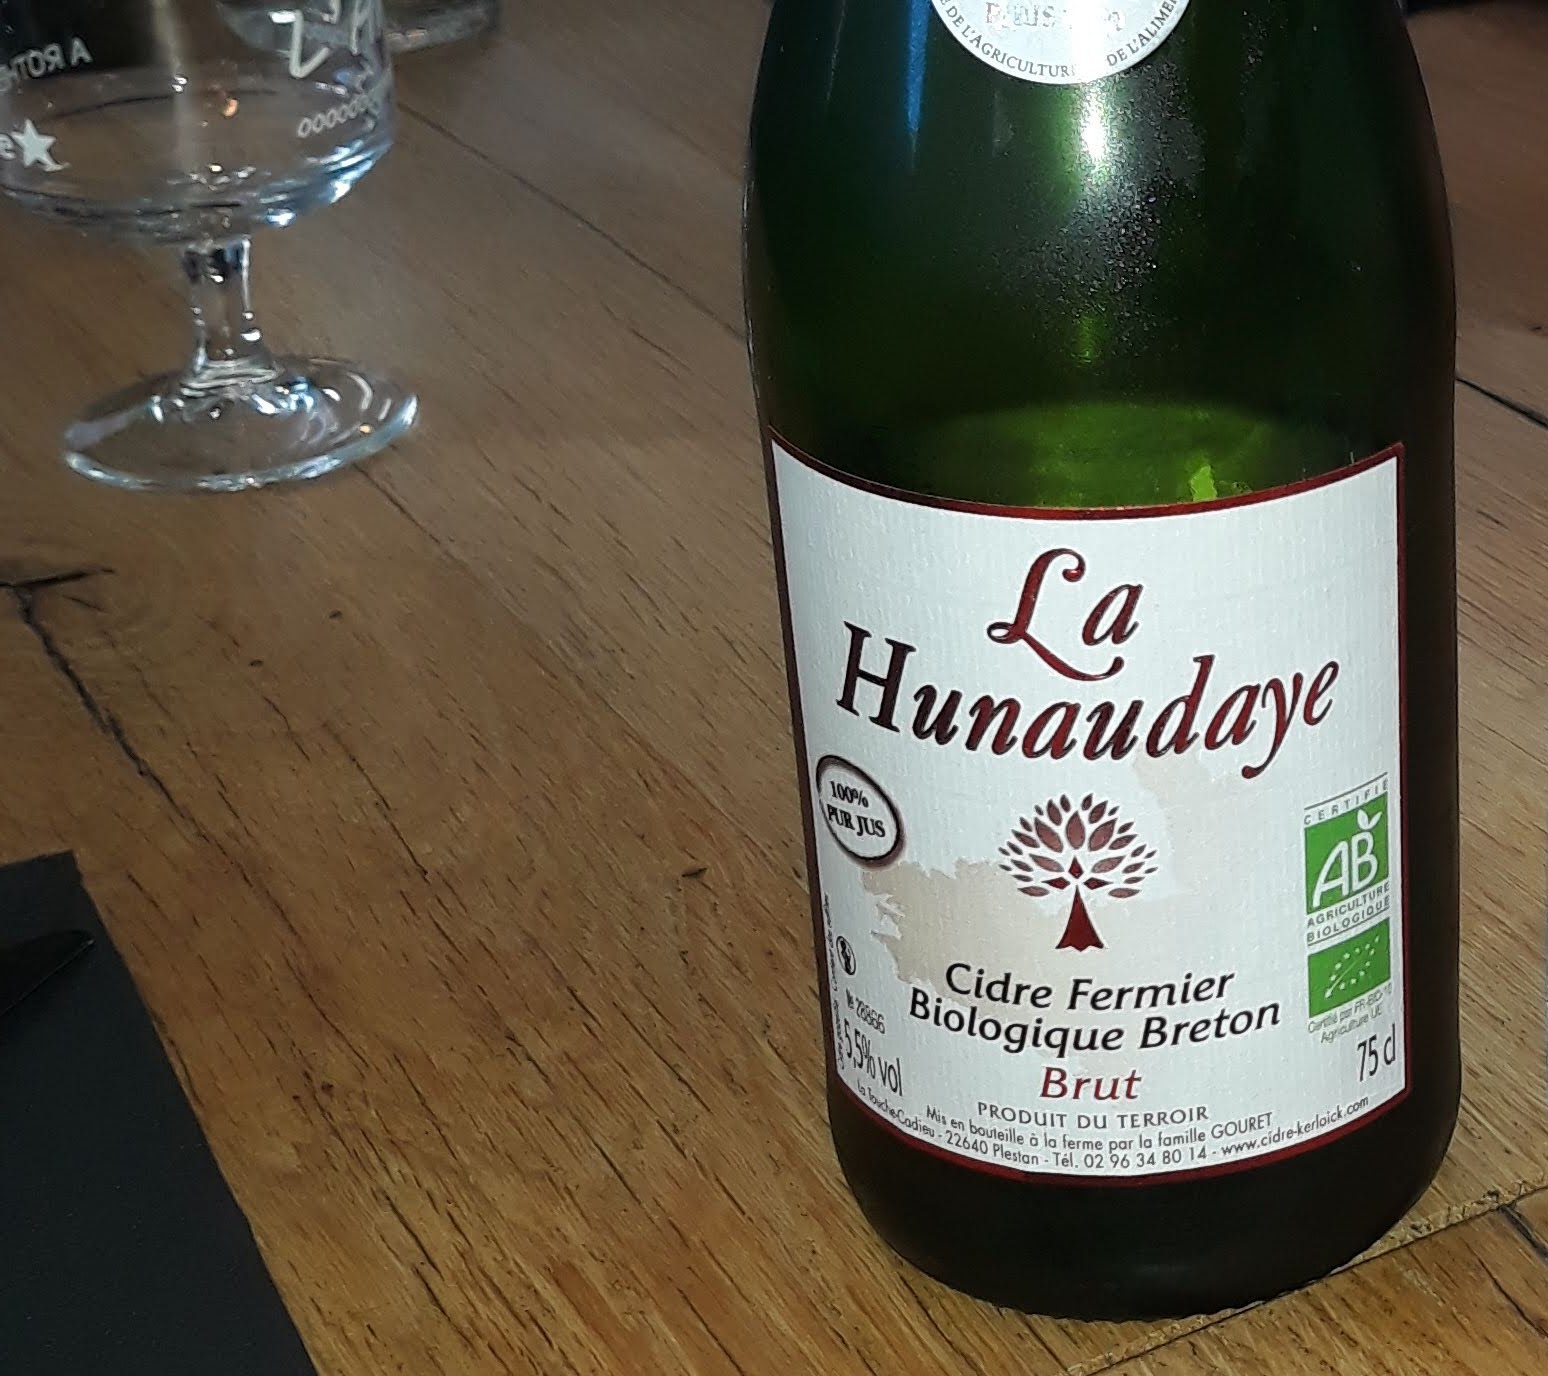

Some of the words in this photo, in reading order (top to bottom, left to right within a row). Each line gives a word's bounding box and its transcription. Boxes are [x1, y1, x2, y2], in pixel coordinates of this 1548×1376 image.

[946, 5, 965, 27] DE
[961, 24, 1076, 78] L'AGRICULTUR
[1106, 48, 1128, 67] DE
[987, 547, 1144, 681] La
[835, 620, 1340, 779] Hunaudaye
[829, 780, 870, 808] 100%
[826, 803, 856, 831] PUR
[856, 814, 886, 838] JUS
[1312, 830, 1379, 909] AB
[1306, 895, 1391, 943] BIOLOGIQUE
[1307, 880, 1390, 929] AGRICULTURE
[944, 962, 1053, 1009] Cidre
[1066, 970, 1236, 1011] Fermier
[909, 986, 1124, 1059] Biologique
[1139, 1001, 1281, 1050] Breton
[844, 1017, 876, 1079] 5,5%
[877, 1056, 903, 1097] vol
[1356, 1033, 1379, 1082] 75
[1383, 1022, 1396, 1066] cl
[1039, 1067, 1143, 1101] Brut
[926, 1105, 947, 1126] Mis
[951, 1118, 965, 1132] en
[969, 1118, 1024, 1145] bouteille
[1029, 1131, 1039, 1147] à
[1044, 1131, 1057, 1148] la
[1062, 1131, 1103, 1151] ferme
[1108, 1138, 1135, 1154] par
[1138, 1133, 1153, 1149] la
[1157, 1127, 1206, 1147] famille
[1210, 1111, 1273, 1140] GOURET
[977, 1101, 1067, 1128] PRODUIT
[1077, 1114, 1108, 1130] DU
[1117, 1105, 1209, 1129] TERROIR
[946, 1129, 989, 1155] 22640
[993, 1143, 1039, 1166] Plestan
[1054, 1150, 1079, 1169] Tél.
[1084, 1153, 1104, 1169] 02
[1110, 1153, 1131, 1169] 96
[1136, 1151, 1157, 1168] 34
[1162, 1148, 1182, 1165] 80
[1189, 1144, 1207, 1161] 14
